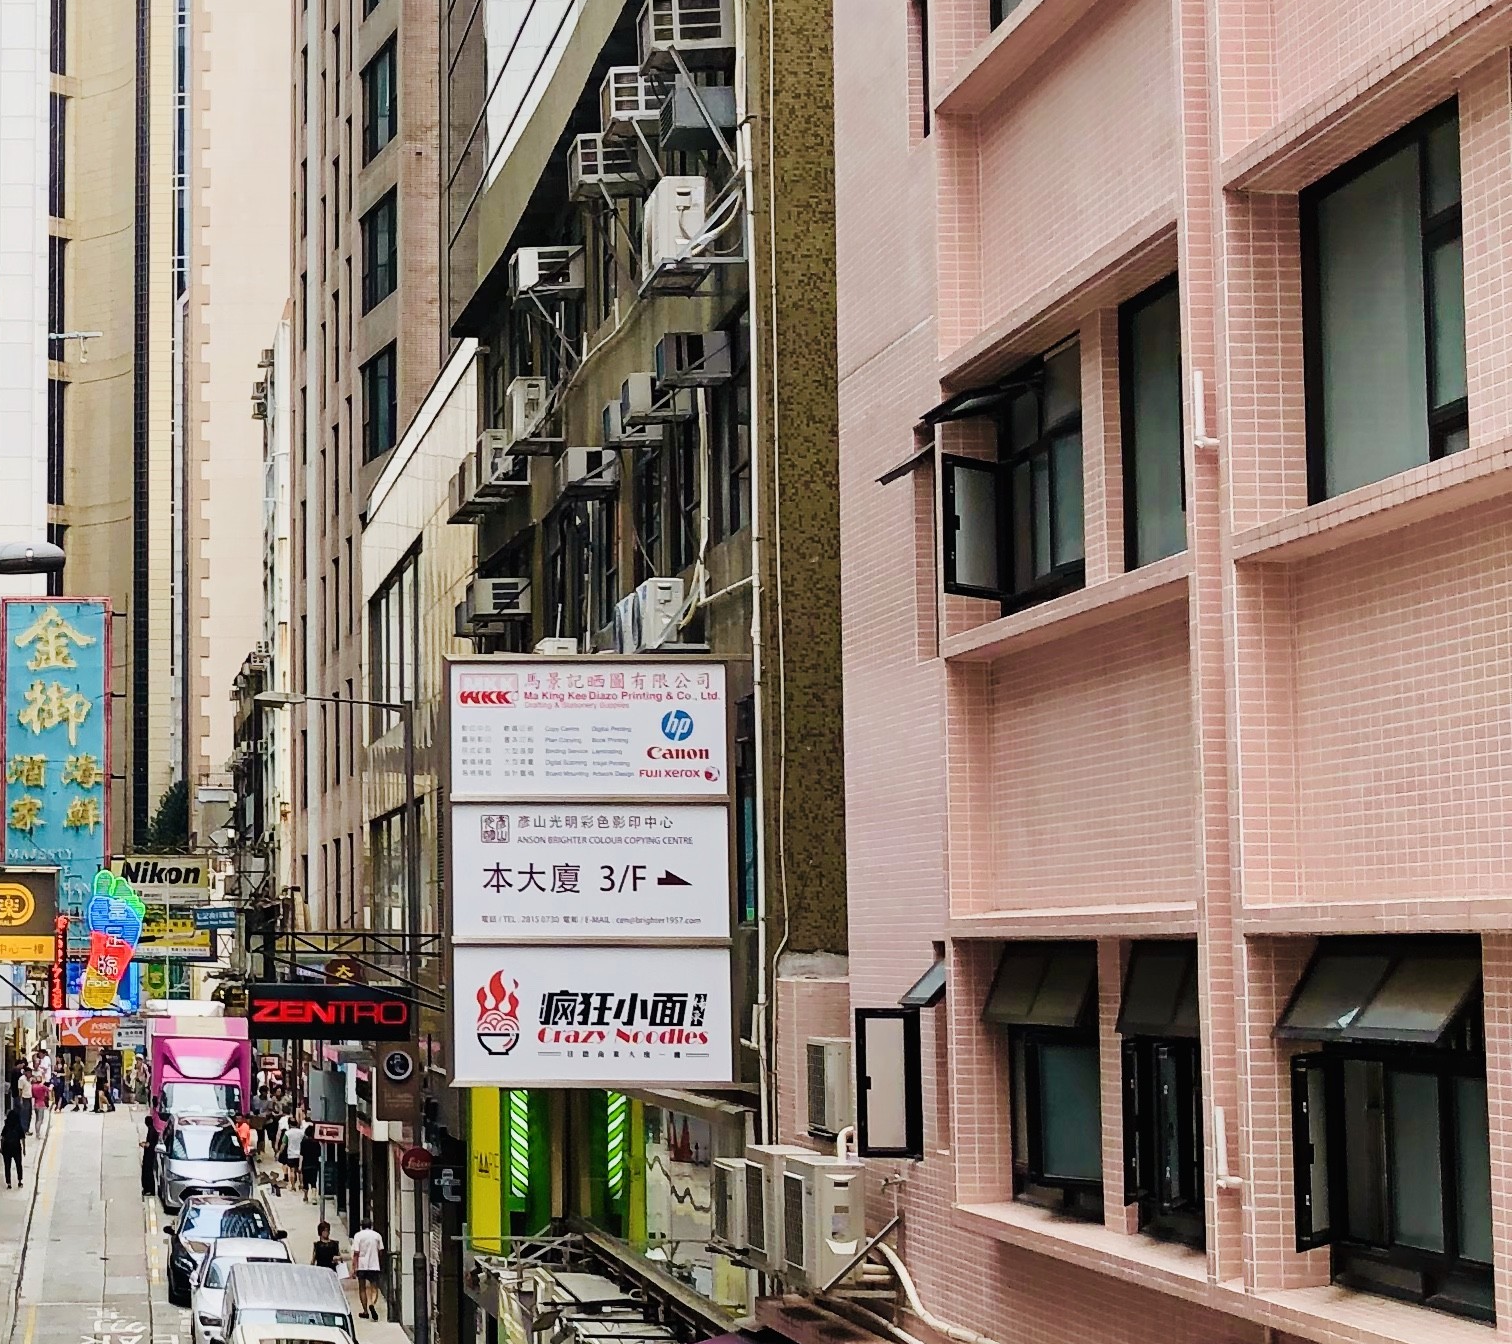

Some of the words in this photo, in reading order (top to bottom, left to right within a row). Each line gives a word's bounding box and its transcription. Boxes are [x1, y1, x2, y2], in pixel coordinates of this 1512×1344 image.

[524, 692, 539, 701] Ma
[542, 692, 564, 702] King
[568, 692, 587, 701] Kee
[589, 691, 617, 701] Diazo
[621, 691, 662, 703] Printing
[665, 692, 674, 701] &
[701, 692, 721, 702] Ltd.
[665, 718, 691, 741] hp
[647, 747, 709, 760] Canon
[639, 769, 662, 778] FUJI
[664, 768, 700, 778] xerox
[517, 815, 674, 829] 彥山光明彩色影印中心
[517, 836, 546, 845] ANSON
[548, 836, 587, 845] BRIGHTER
[588, 836, 623, 845] COLOUR
[624, 836, 661, 845] COPYING
[663, 836, 693, 845] CENTRE
[122, 861, 200, 885] Nikon
[483, 862, 581, 894] 本大廈
[599, 864, 647, 893] 3/F
[252, 999, 408, 1025] ZENTRO
[539, 990, 689, 1027] 疯狂小面
[538, 1027, 609, 1044] Crazy
[614, 1028, 709, 1045] Noodles
